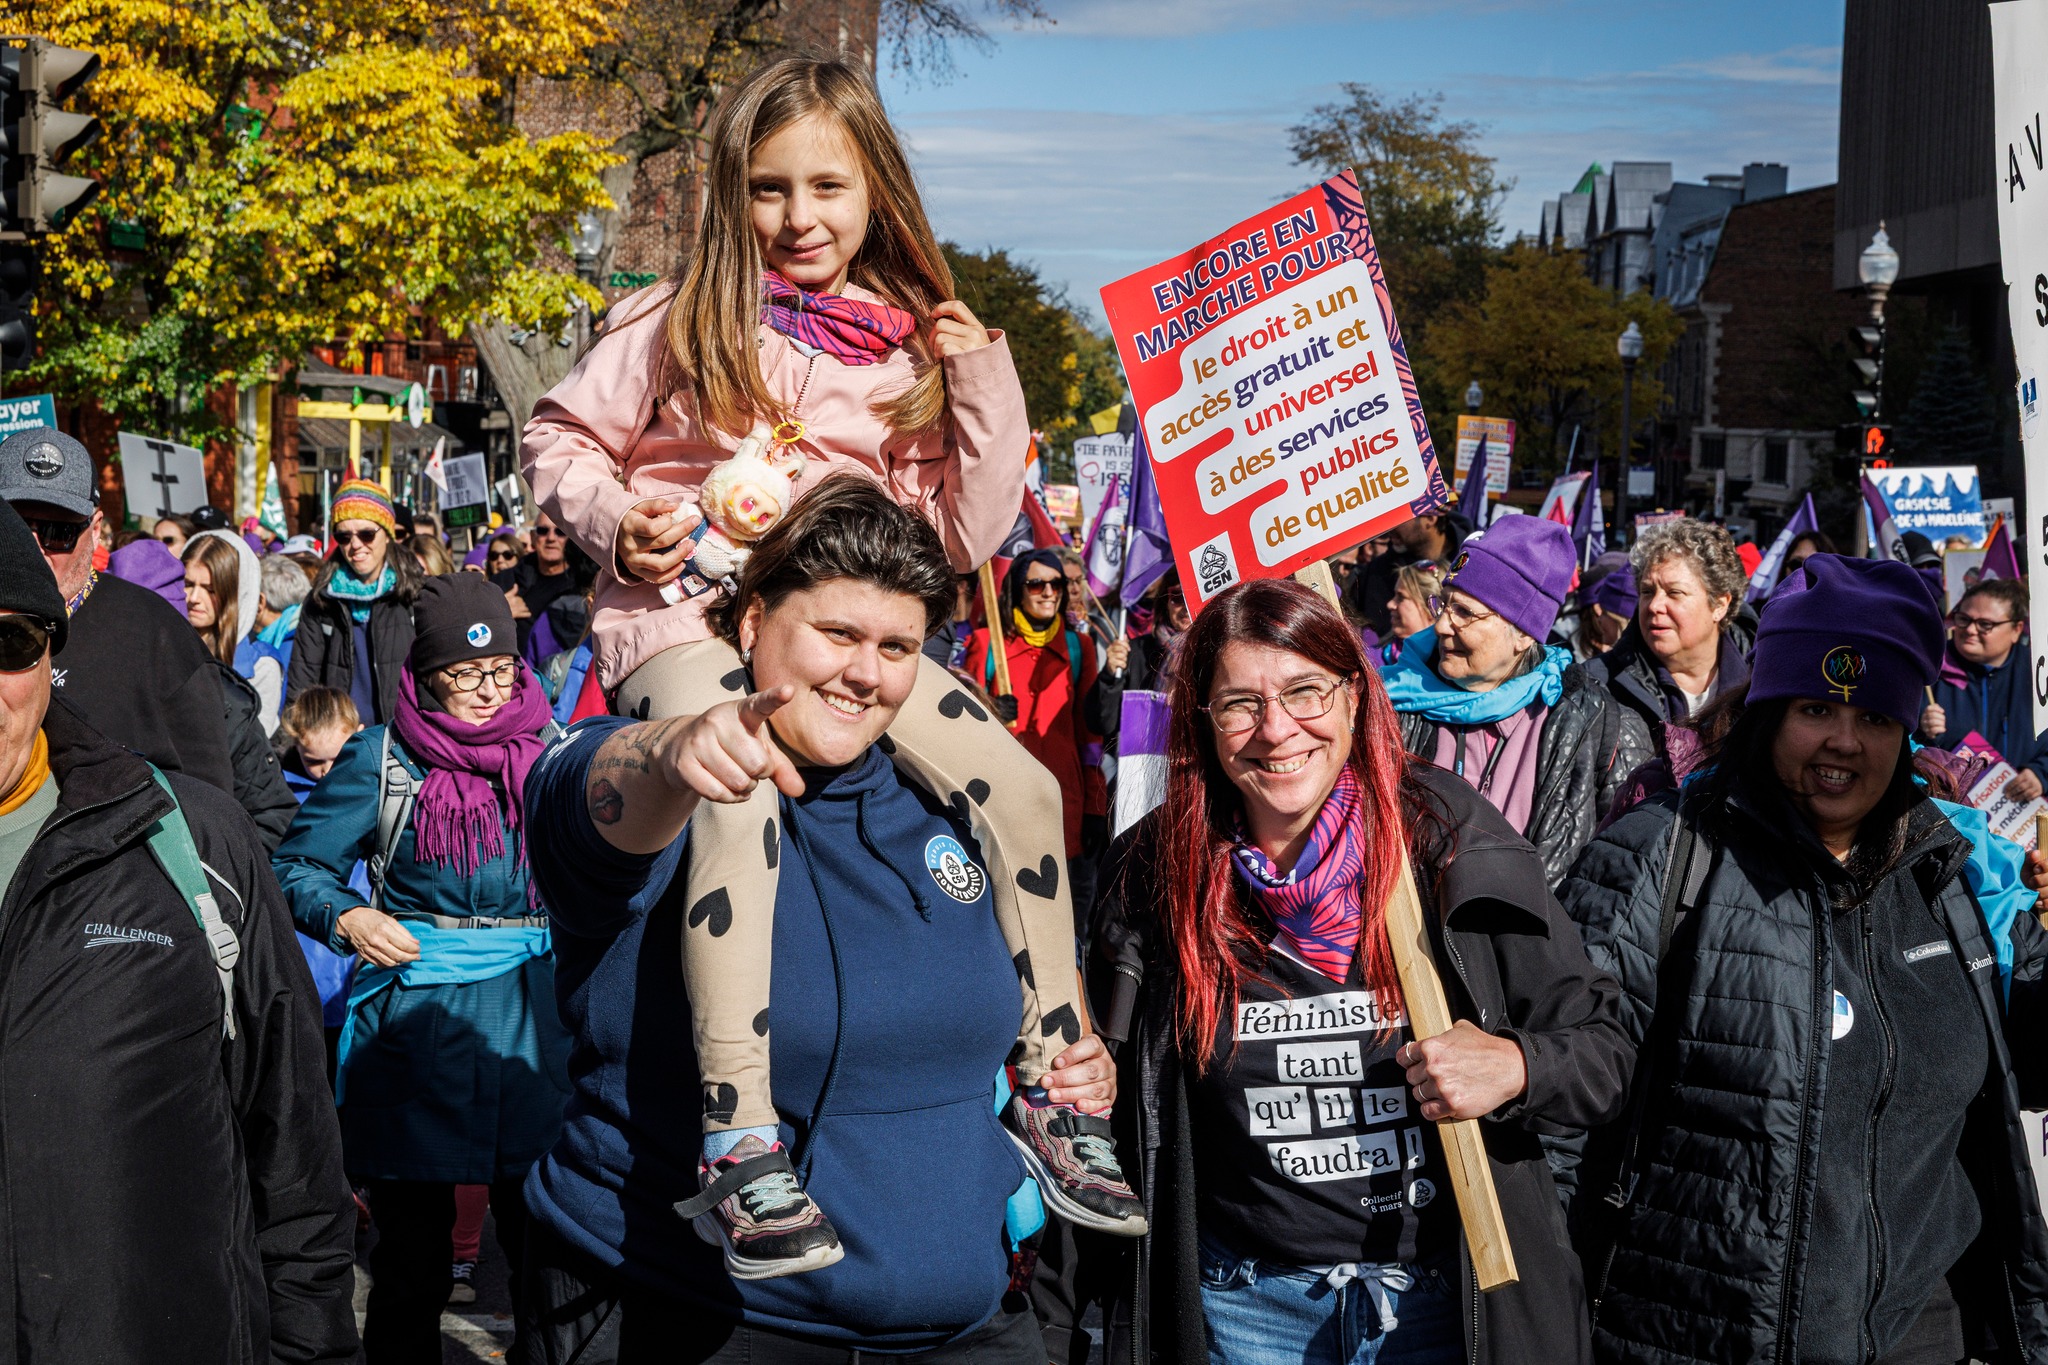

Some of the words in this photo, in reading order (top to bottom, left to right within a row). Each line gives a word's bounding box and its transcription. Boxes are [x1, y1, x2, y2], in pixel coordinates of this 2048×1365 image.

[1152, 229, 1271, 314] ENCORE
[1272, 206, 1319, 249] EN
[1133, 272, 1258, 363] MARCHE
[1260, 231, 1353, 294] POUR
[1192, 356, 1218, 385] le
[1220, 315, 1291, 366] droit
[1292, 303, 1313, 330] à
[1317, 285, 1359, 318] un
[1160, 388, 1231, 445] accès
[1234, 336, 1334, 409] gratuit
[1337, 318, 1370, 350] et
[1244, 350, 1379, 437] universel
[1209, 470, 1227, 497] à
[1229, 447, 1275, 485] des
[1278, 393, 1389, 460] services
[1300, 428, 1399, 496] publics
[1265, 515, 1302, 547] de
[1305, 457, 1410, 531] qualité
[1204, 569, 1233, 593] CSN
[935, 866, 981, 899] CONSTRUCTION
[951, 874, 967, 884] CSN
[84, 923, 175, 947] CHALLENGER
[1916, 943, 1948, 957] Columbia
[1239, 998, 1401, 1035] féministe
[1284, 1051, 1358, 1079] tant
[1324, 1094, 1349, 1121] il
[1368, 1093, 1400, 1117] le
[1277, 1143, 1393, 1178] faudra
[1410, 1133, 1420, 1163] !
[1361, 1190, 1402, 1206] Collectif
[1371, 1205, 1378, 1213] 8
[1380, 1201, 1403, 1212] mars
